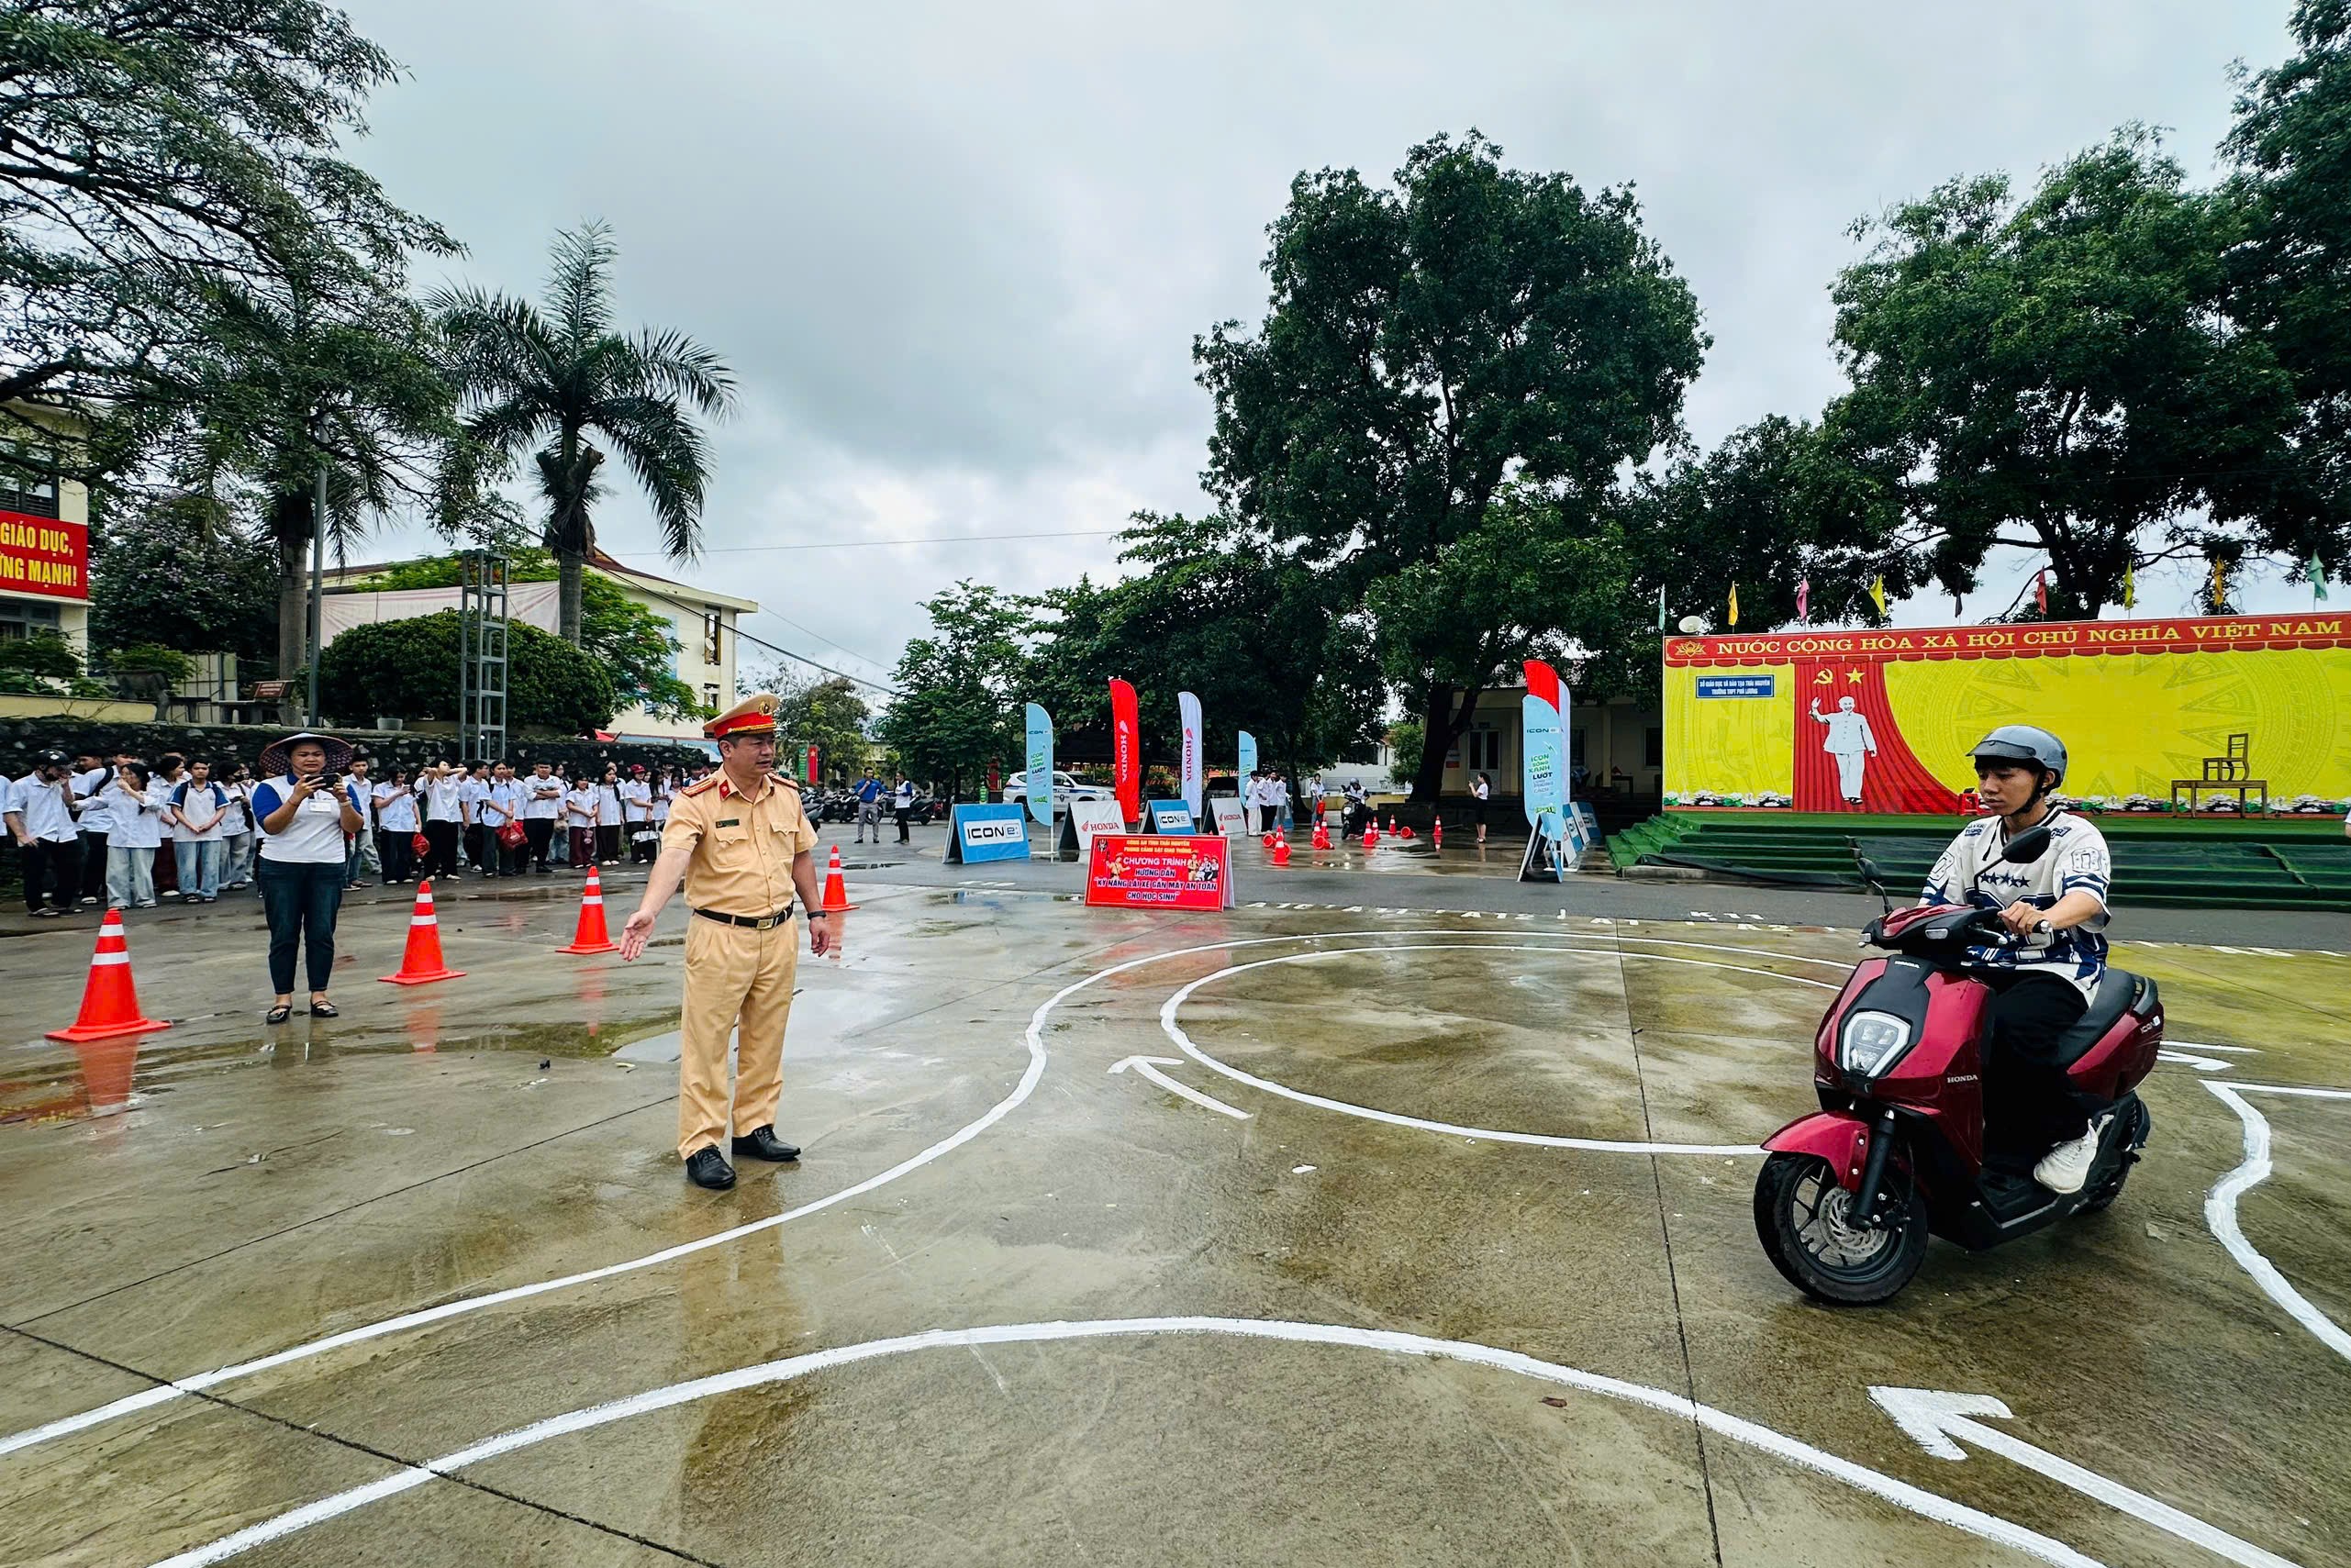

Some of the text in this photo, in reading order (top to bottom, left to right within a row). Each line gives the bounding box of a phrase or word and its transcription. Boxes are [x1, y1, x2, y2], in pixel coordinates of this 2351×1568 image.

[0, 520, 74, 557] GIÁO DỤC,
[28, 560, 78, 588] MẠNH!
[1786, 637, 1854, 654] CỘNG
[1860, 633, 1913, 651] HÒA
[1922, 633, 1962, 648] XÃ
[1967, 629, 2015, 648] HỘI
[2022, 626, 2079, 644] CHỦ
[2087, 626, 2181, 643] NGHĨA
[2189, 621, 2261, 640] VIỆT
[2268, 621, 2343, 637] NAM
[1120, 734, 1129, 784] HONDA
[1186, 740, 1194, 782] HONDA
[967, 826, 1005, 840] ICON
[1090, 822, 1120, 831] HONDA
[1163, 856, 1187, 866] TRÌNH
[1947, 1074, 1978, 1084] HONDA
